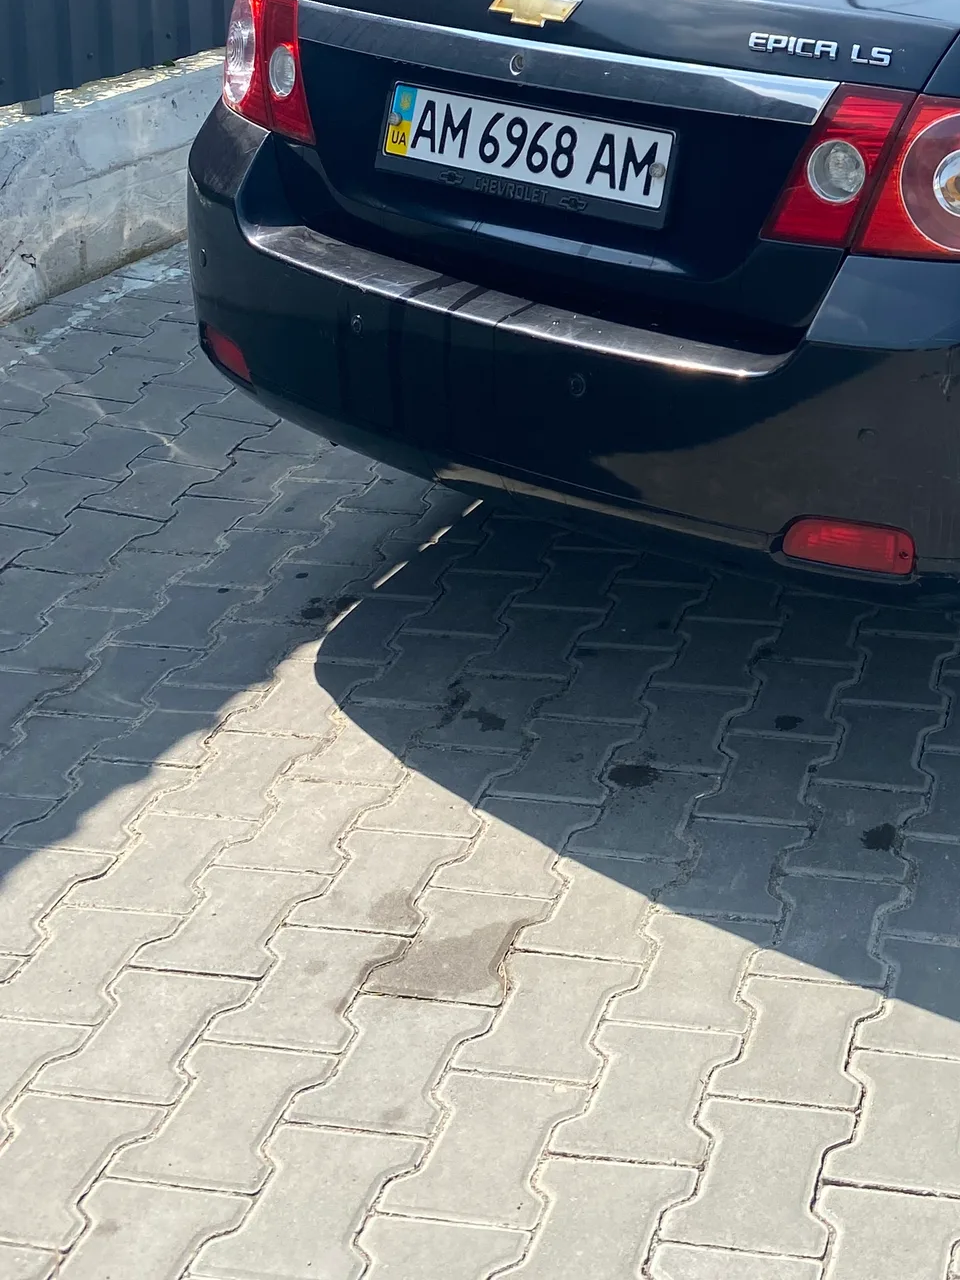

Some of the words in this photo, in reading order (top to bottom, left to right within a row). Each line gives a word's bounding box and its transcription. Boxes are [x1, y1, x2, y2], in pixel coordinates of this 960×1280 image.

[748, 31, 838, 60] EPICA
[850, 44, 893, 67] LS
[391, 129, 408, 147] UA
[410, 99, 473, 159] AM
[478, 112, 578, 179] 6968
[585, 132, 659, 196] AM
[473, 176, 548, 204] CHEVROLET
